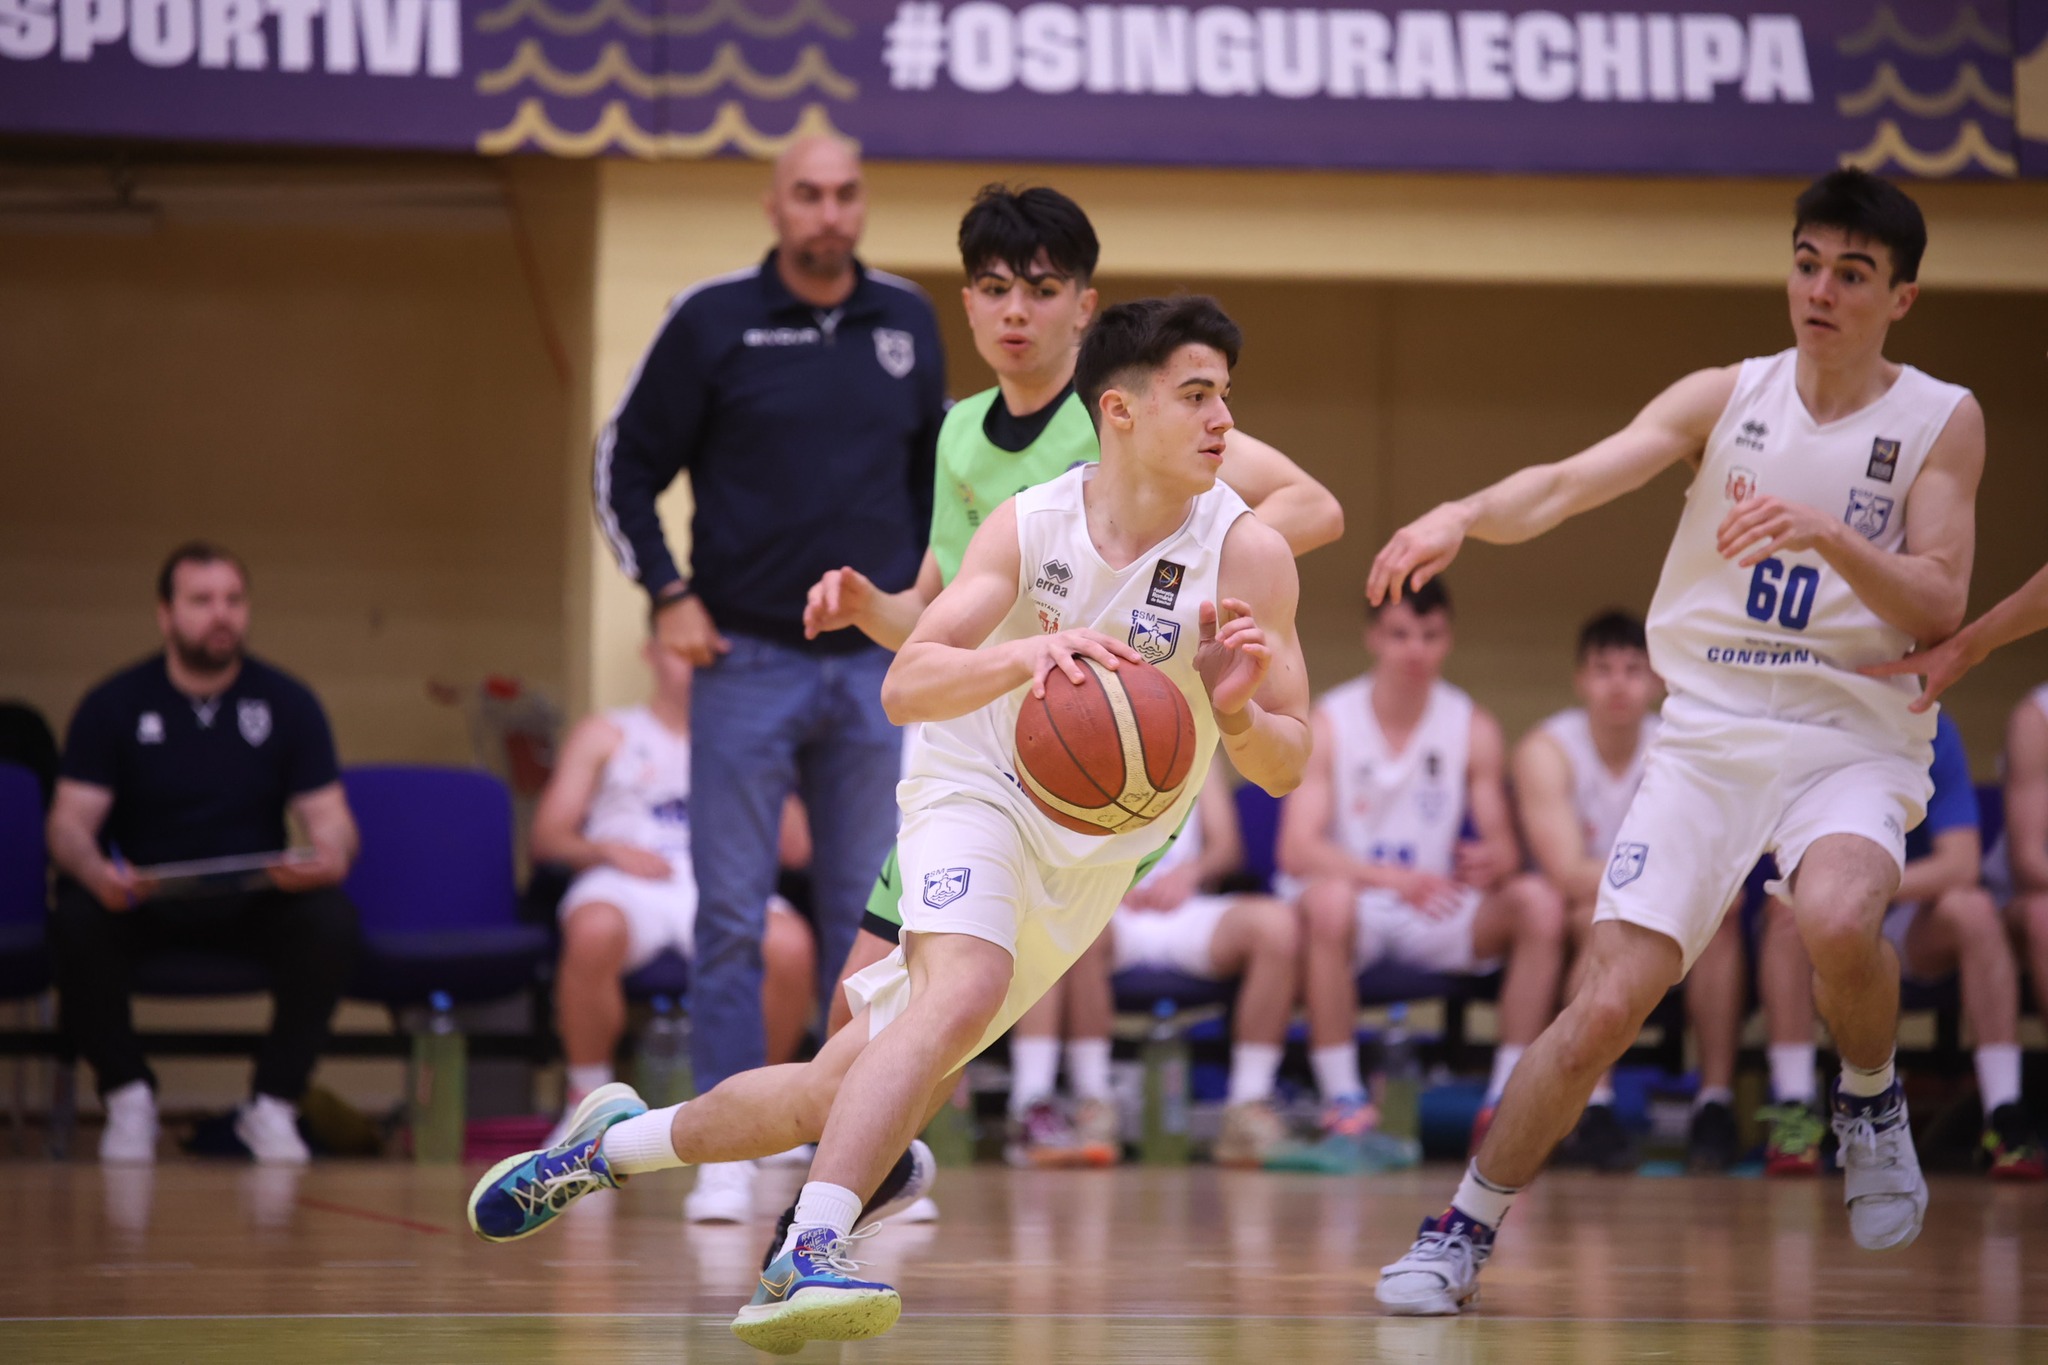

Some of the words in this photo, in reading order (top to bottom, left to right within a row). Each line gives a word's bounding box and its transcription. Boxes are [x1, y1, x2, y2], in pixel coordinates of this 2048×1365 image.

[0, 0, 463, 78] SPORTIVI
[883, 2, 1813, 103] #OSINGURAECHIPA
[1746, 556, 1820, 631] 60
